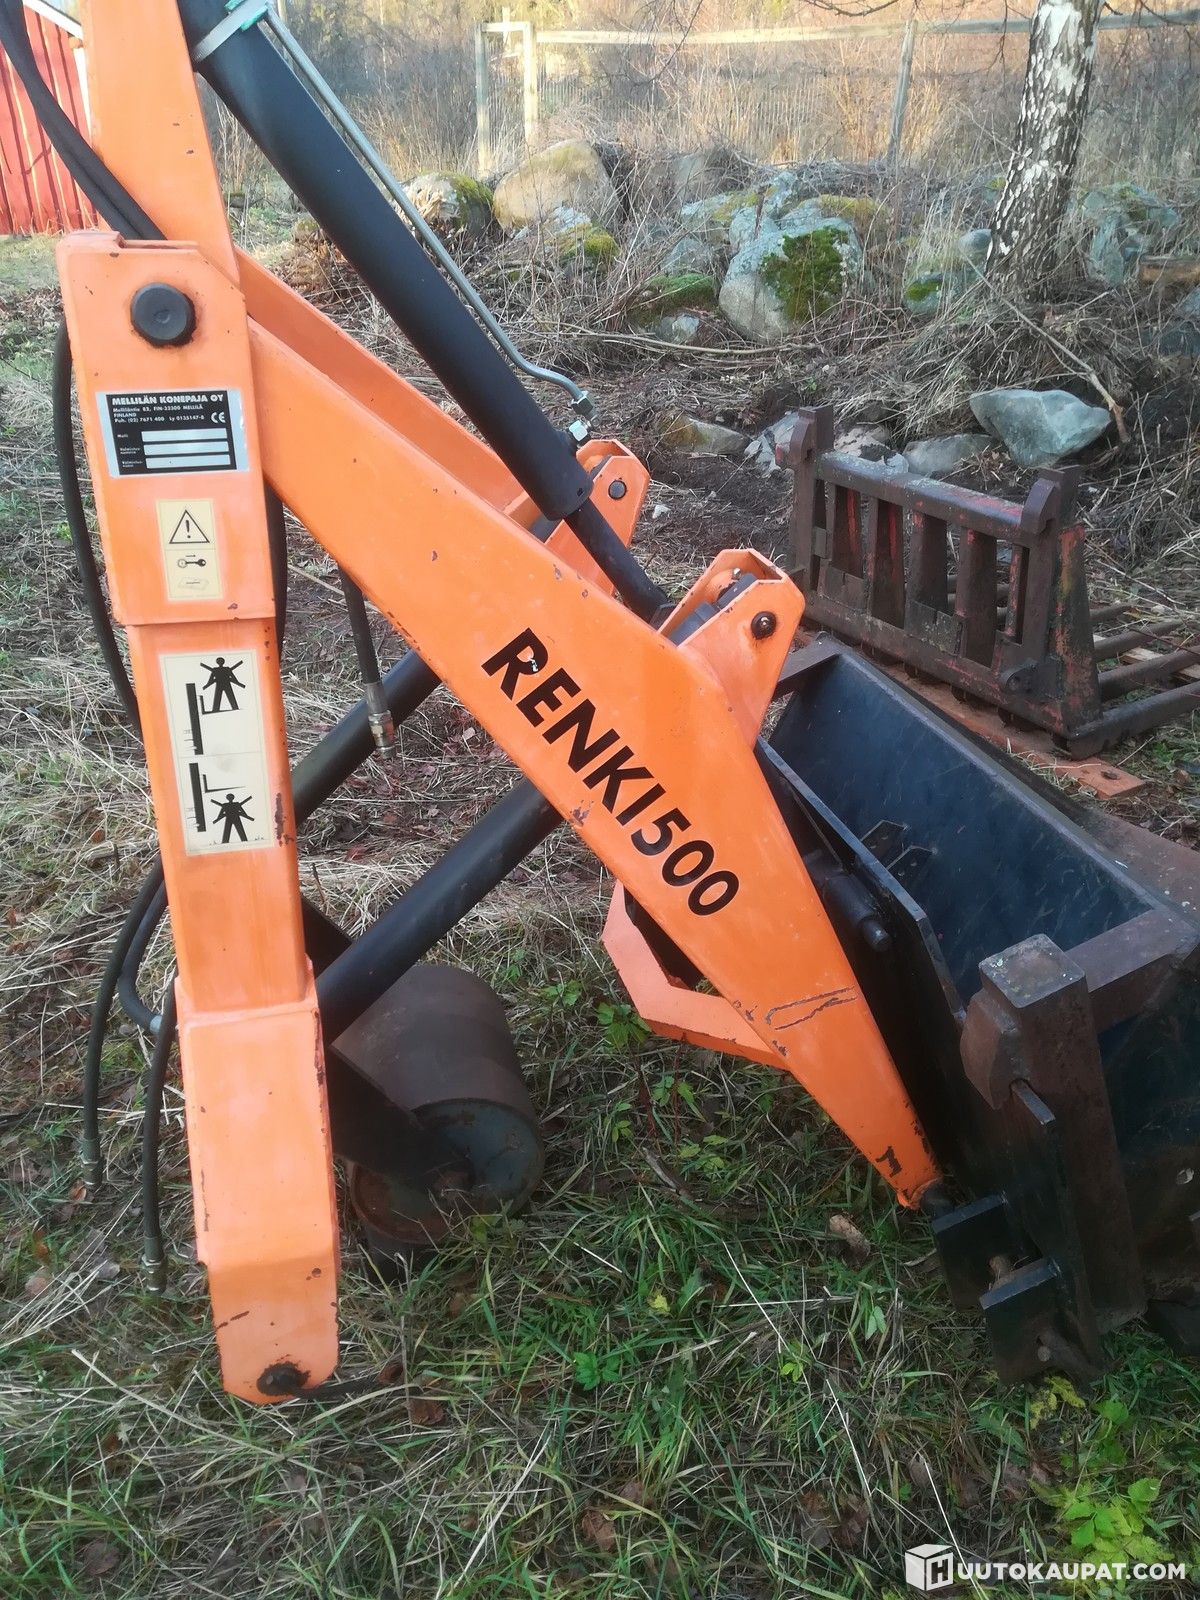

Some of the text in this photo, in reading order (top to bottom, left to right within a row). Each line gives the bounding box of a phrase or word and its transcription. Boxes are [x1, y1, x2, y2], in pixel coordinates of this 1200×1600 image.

[112, 394, 224, 405] MELLILÄN KONEPAJA OY
